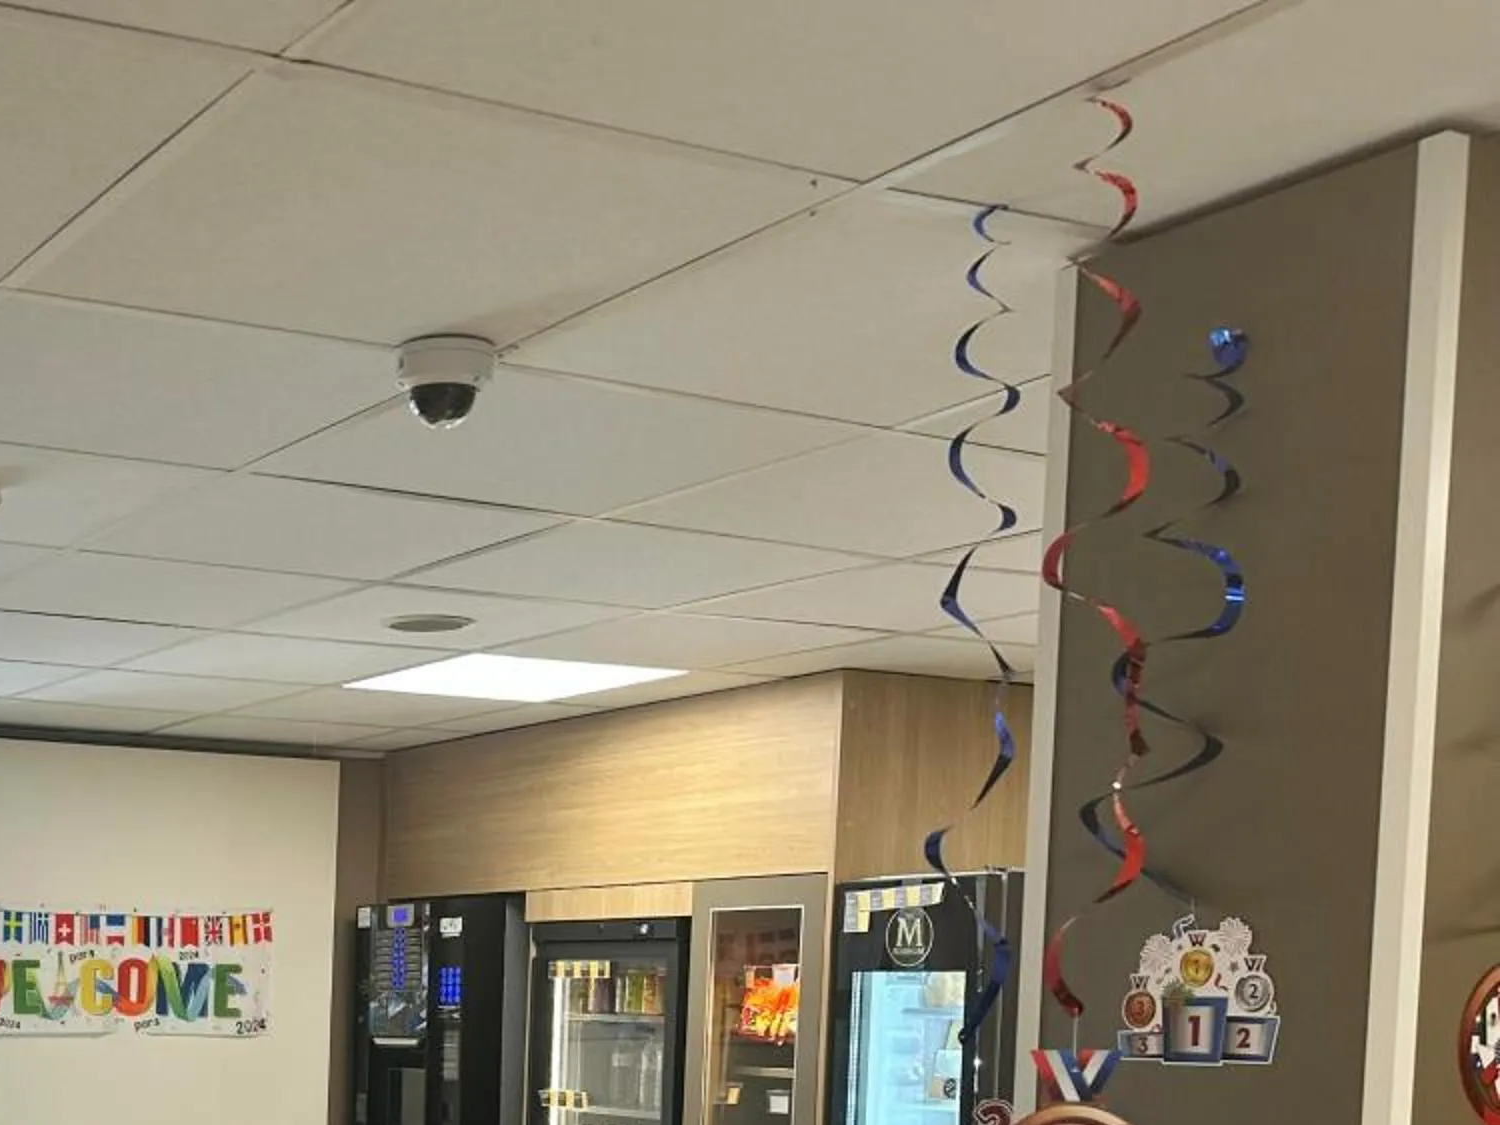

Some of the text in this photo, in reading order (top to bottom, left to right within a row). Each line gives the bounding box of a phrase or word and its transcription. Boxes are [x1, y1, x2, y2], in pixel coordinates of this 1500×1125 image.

[896, 917, 923, 947] M
[235, 1017, 268, 1035] 2024
[1187, 1015, 1201, 1047] 1
[1137, 1037, 1149, 1054] 3
[1236, 1027, 1251, 1049] 2
